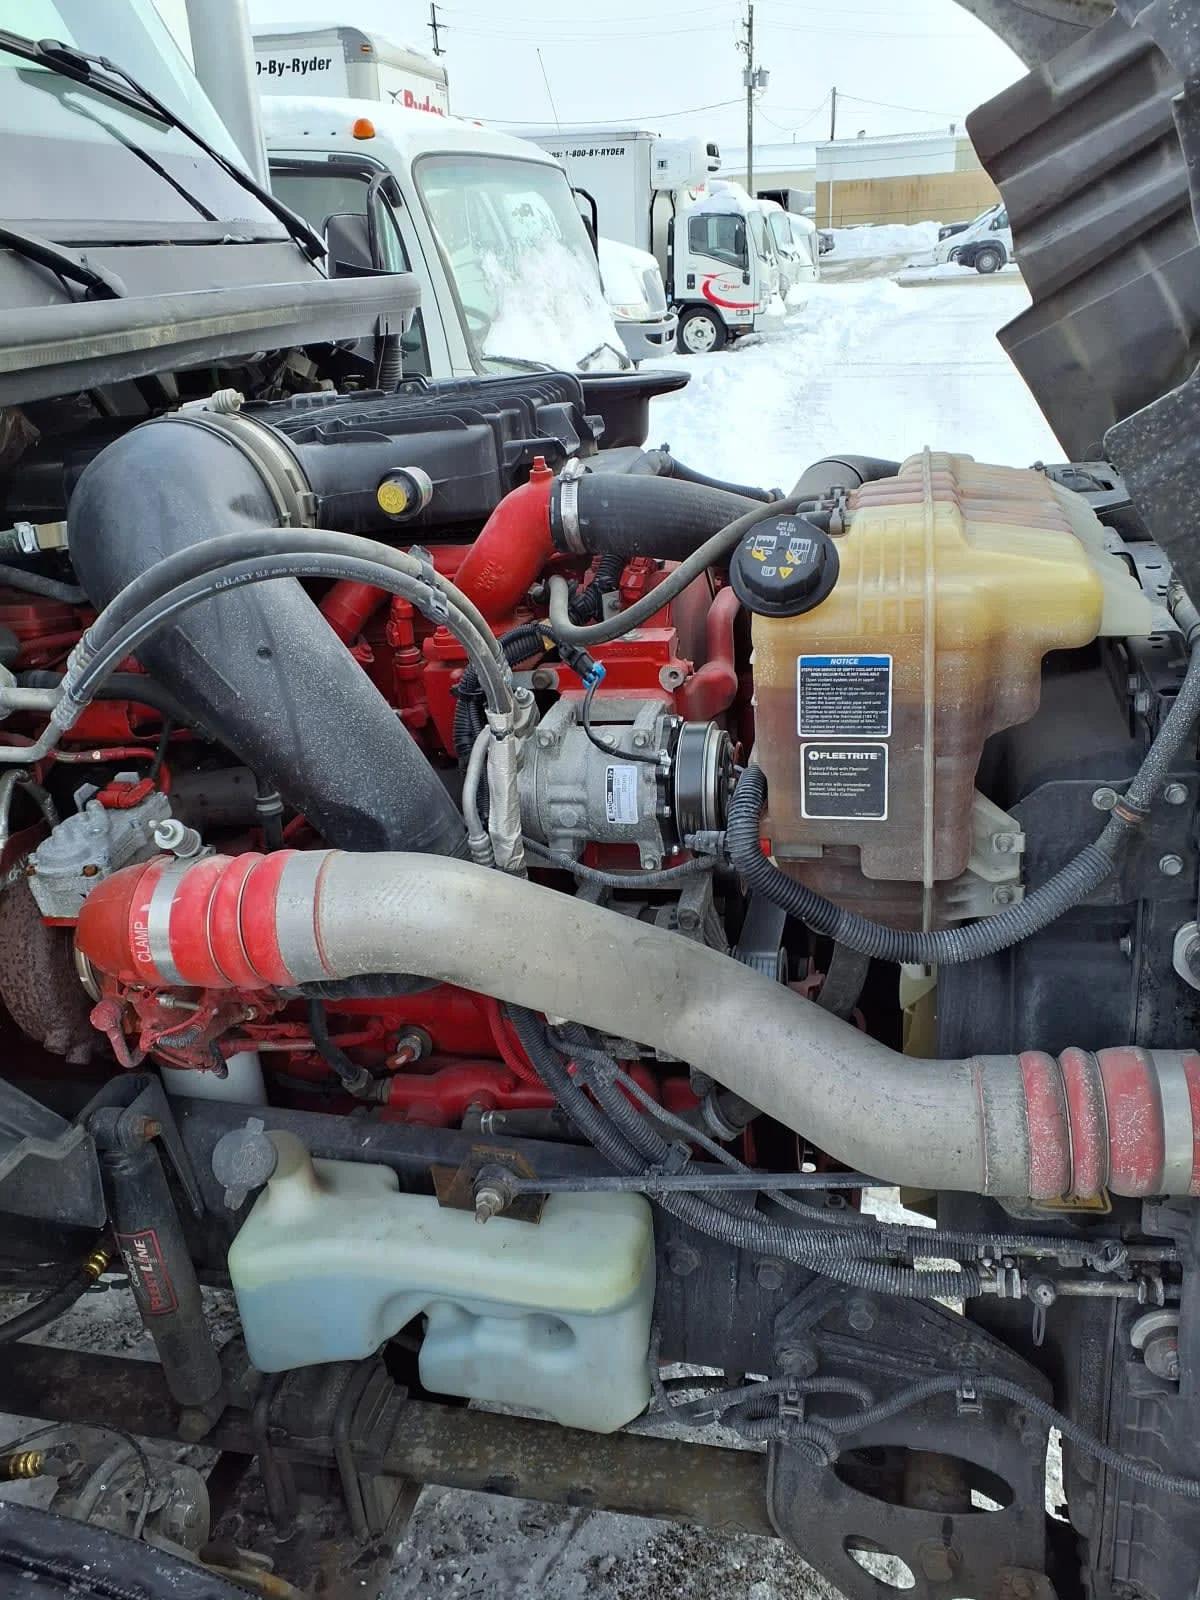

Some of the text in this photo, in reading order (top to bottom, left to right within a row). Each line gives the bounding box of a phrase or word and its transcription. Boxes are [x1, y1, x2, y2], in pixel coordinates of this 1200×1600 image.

[566, 148, 625, 158] 1-800-BY-RYDER
[216, 572, 253, 589] GALAXY
[134, 922, 152, 962] CLAMP
